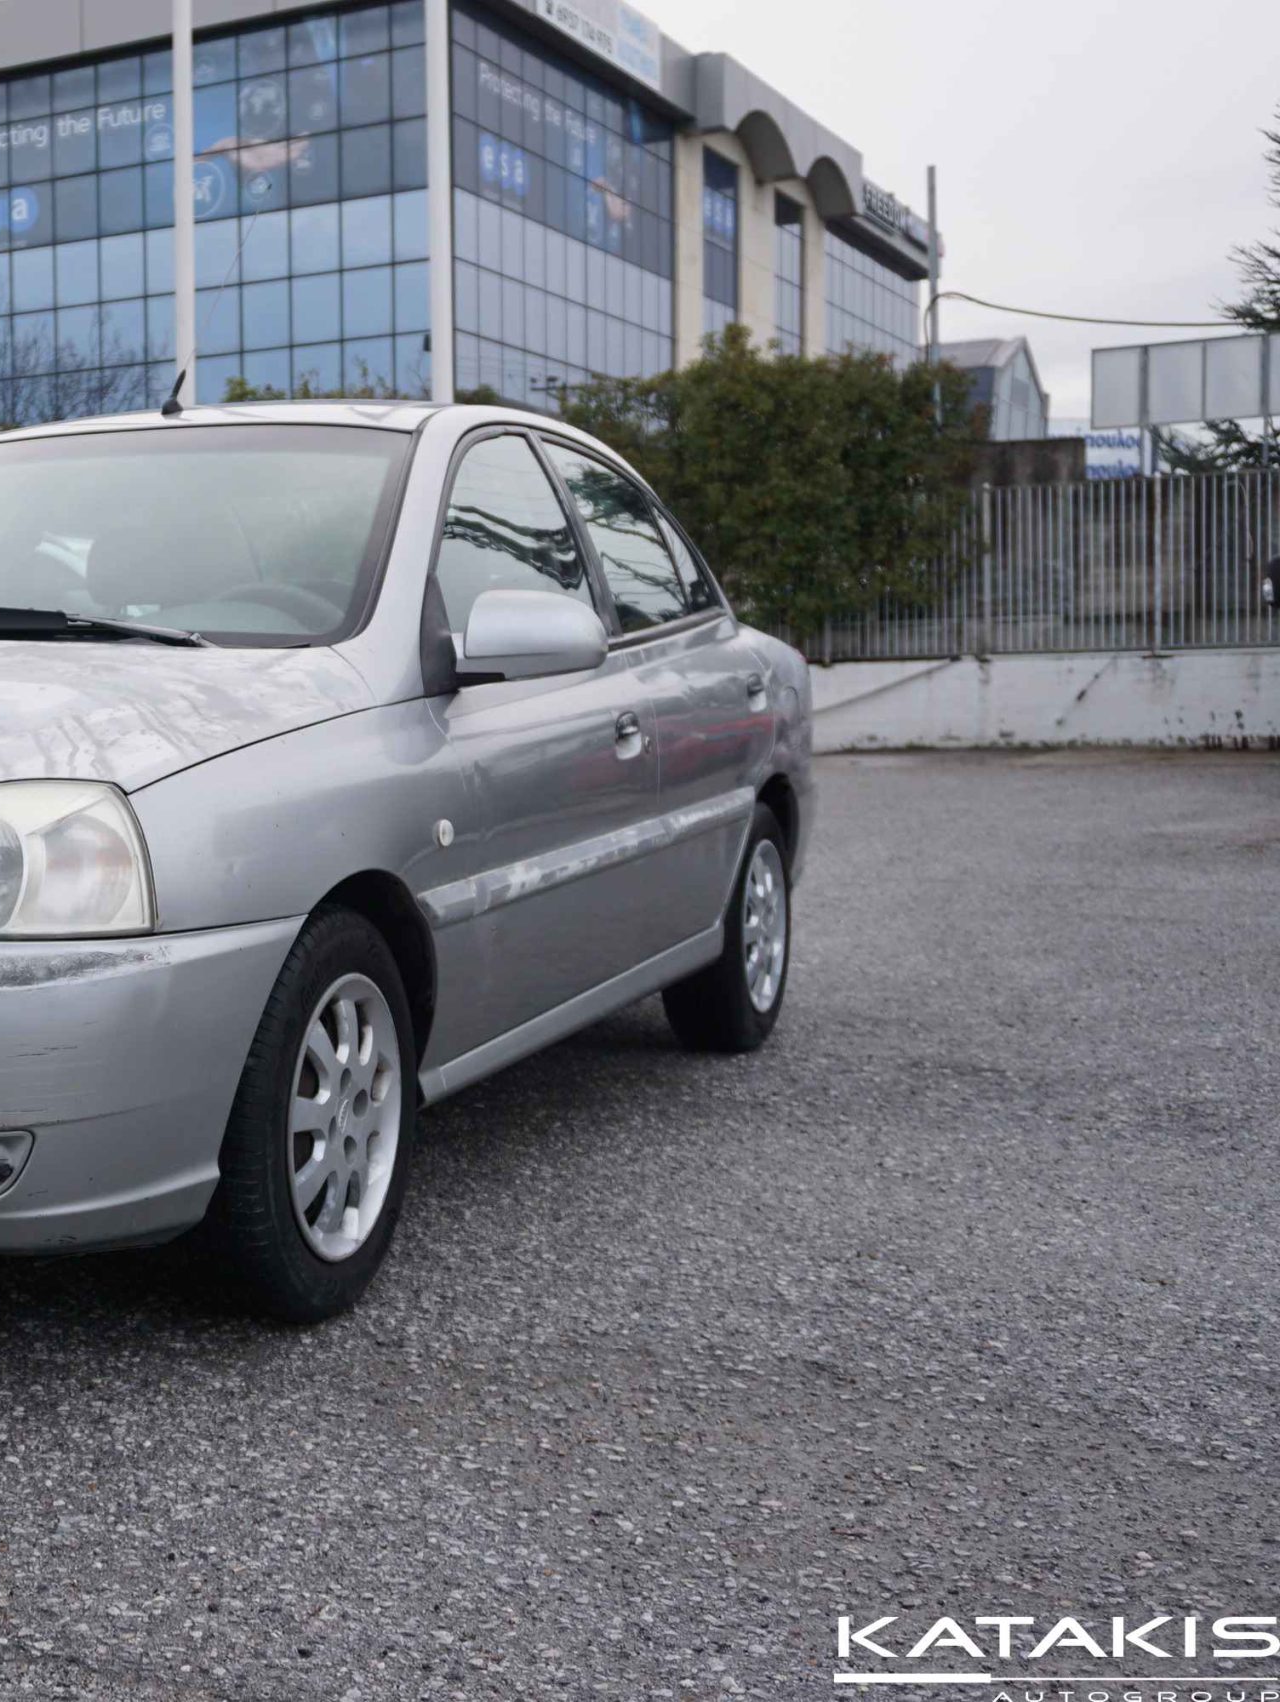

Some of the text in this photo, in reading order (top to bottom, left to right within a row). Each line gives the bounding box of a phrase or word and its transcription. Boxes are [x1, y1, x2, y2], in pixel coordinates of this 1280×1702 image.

[57, 114, 91, 137] the
[97, 102, 166, 130] Future
[483, 144, 524, 185] esa
